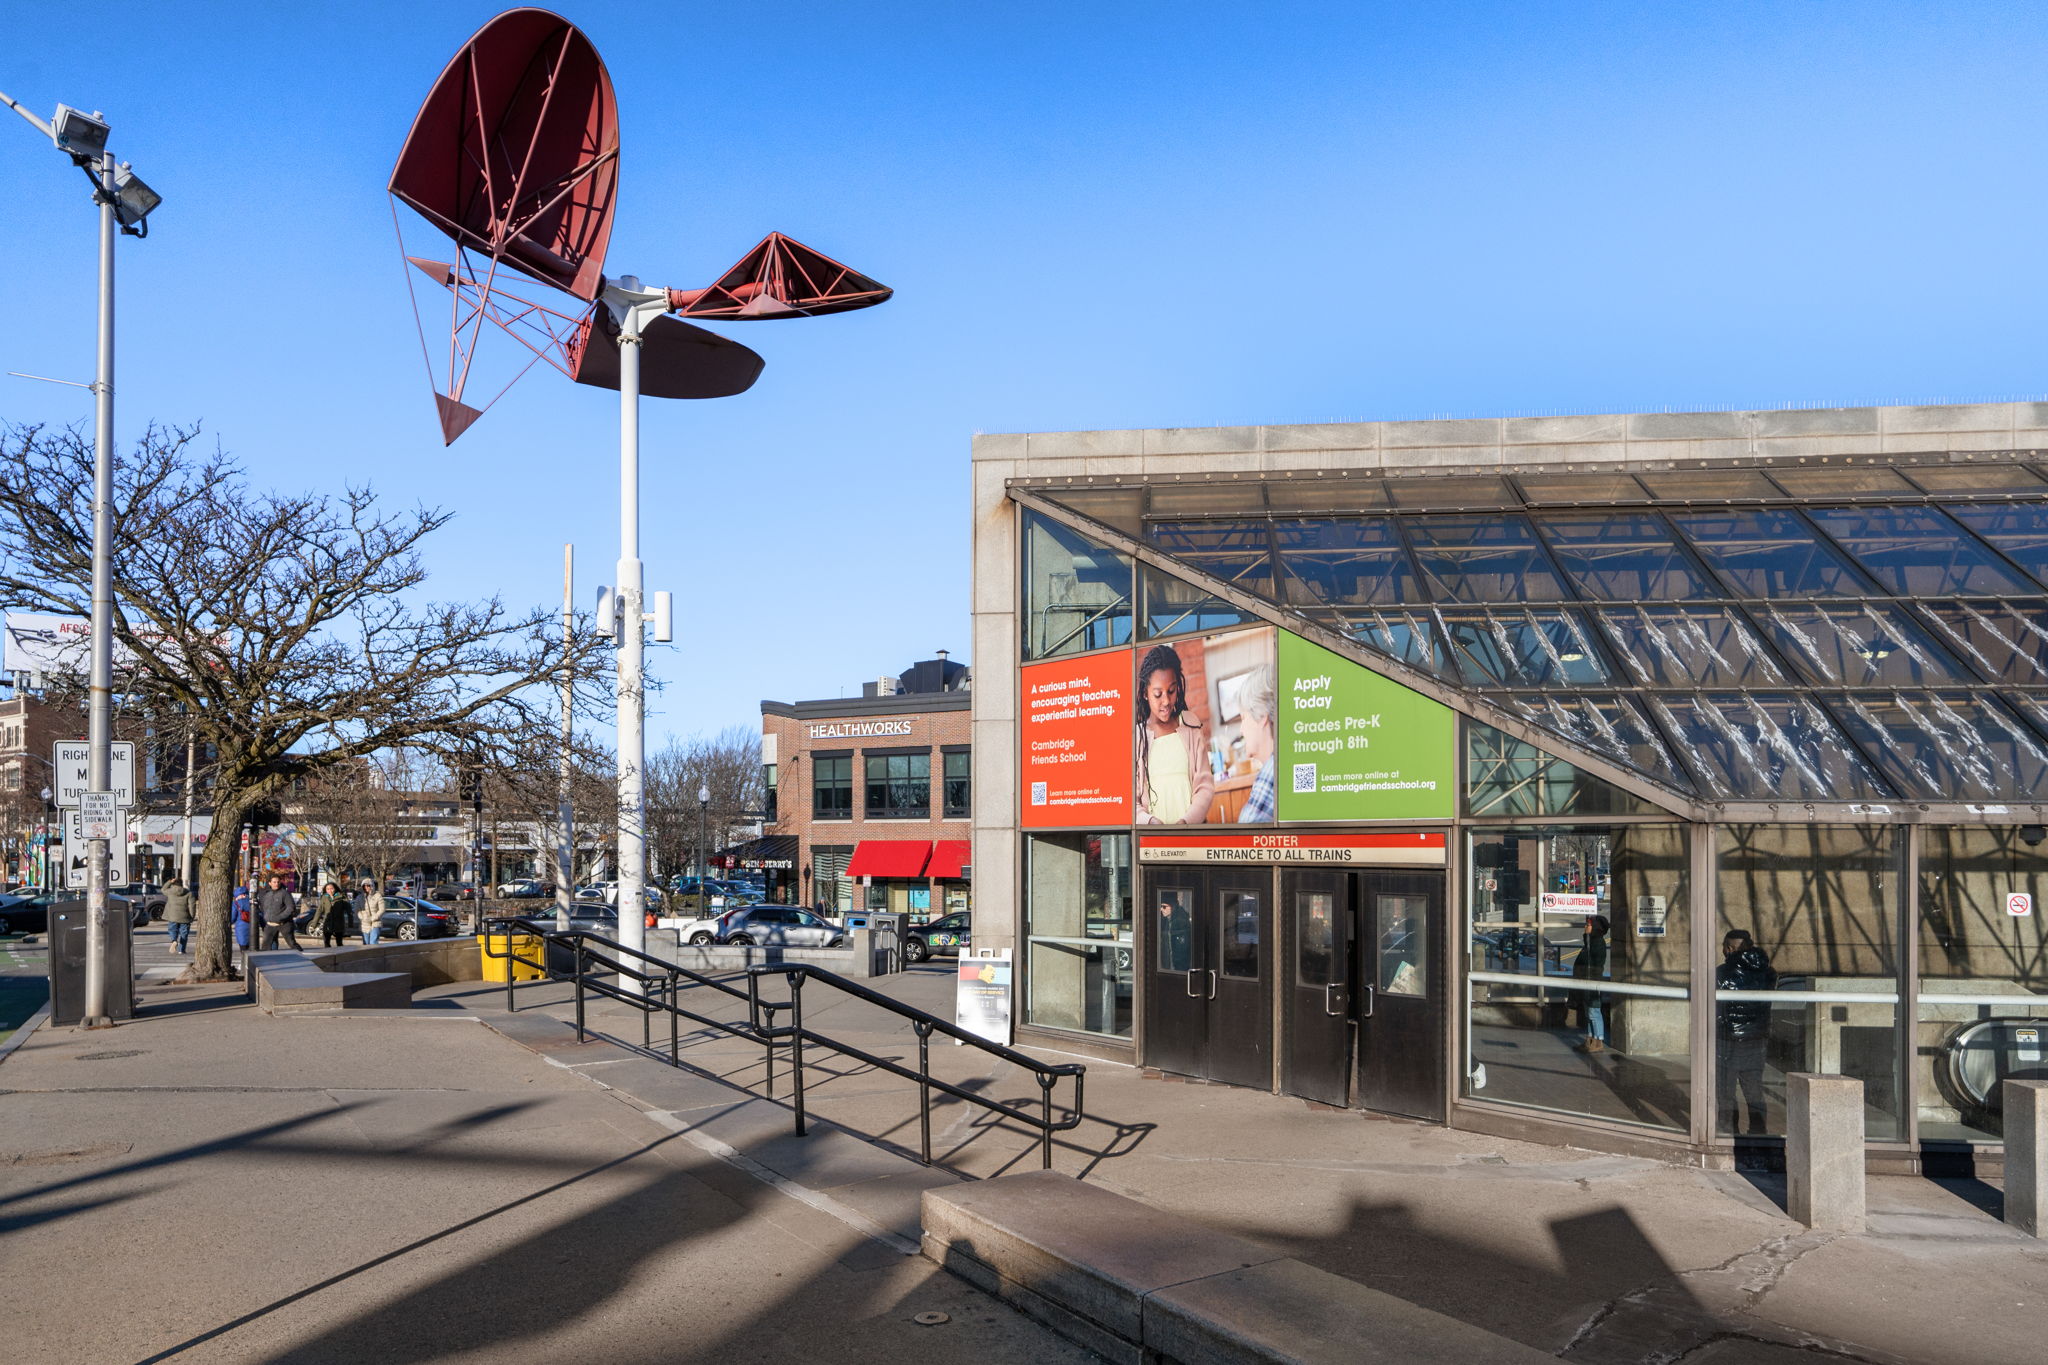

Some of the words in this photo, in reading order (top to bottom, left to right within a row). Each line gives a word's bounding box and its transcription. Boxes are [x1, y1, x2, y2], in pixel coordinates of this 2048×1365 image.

[1031, 684, 1037, 694] A
[1038, 682, 1067, 693] curious
[1068, 676, 1091, 689] mind,
[1293, 675, 1331, 692] Apply
[1031, 694, 1080, 708] encouraging
[1082, 689, 1121, 702] teachers,
[1293, 695, 1332, 709] Today
[1031, 708, 1077, 723] experiential
[1079, 705, 1115, 717] learning.
[810, 720, 911, 738] HEALTHWORKS
[1294, 718, 1341, 734] Grades
[1344, 714, 1380, 730] Pre-K
[1031, 739, 1075, 751] Cambridge
[1293, 737, 1343, 754] through
[1347, 735, 1368, 749] 8th
[1031, 754, 1058, 765] Friends
[1059, 752, 1087, 763] School
[1321, 773, 1341, 782] Learn
[1364, 771, 1389, 779] online
[1390, 770, 1400, 778] at
[1321, 780, 1436, 793] cambridgefriendsschool.org
[1049, 796, 1123, 806] cambridgefriendsschool.org
[1253, 836, 1298, 847] PORTER
[1206, 849, 1264, 860] ENTRANCE
[1266, 849, 1282, 860] TO
[1284, 849, 1305, 860] ALL
[1308, 849, 1352, 861] TRAINS
[1557, 897, 1566, 905] NO
[1567, 897, 1595, 906] LOITERING
